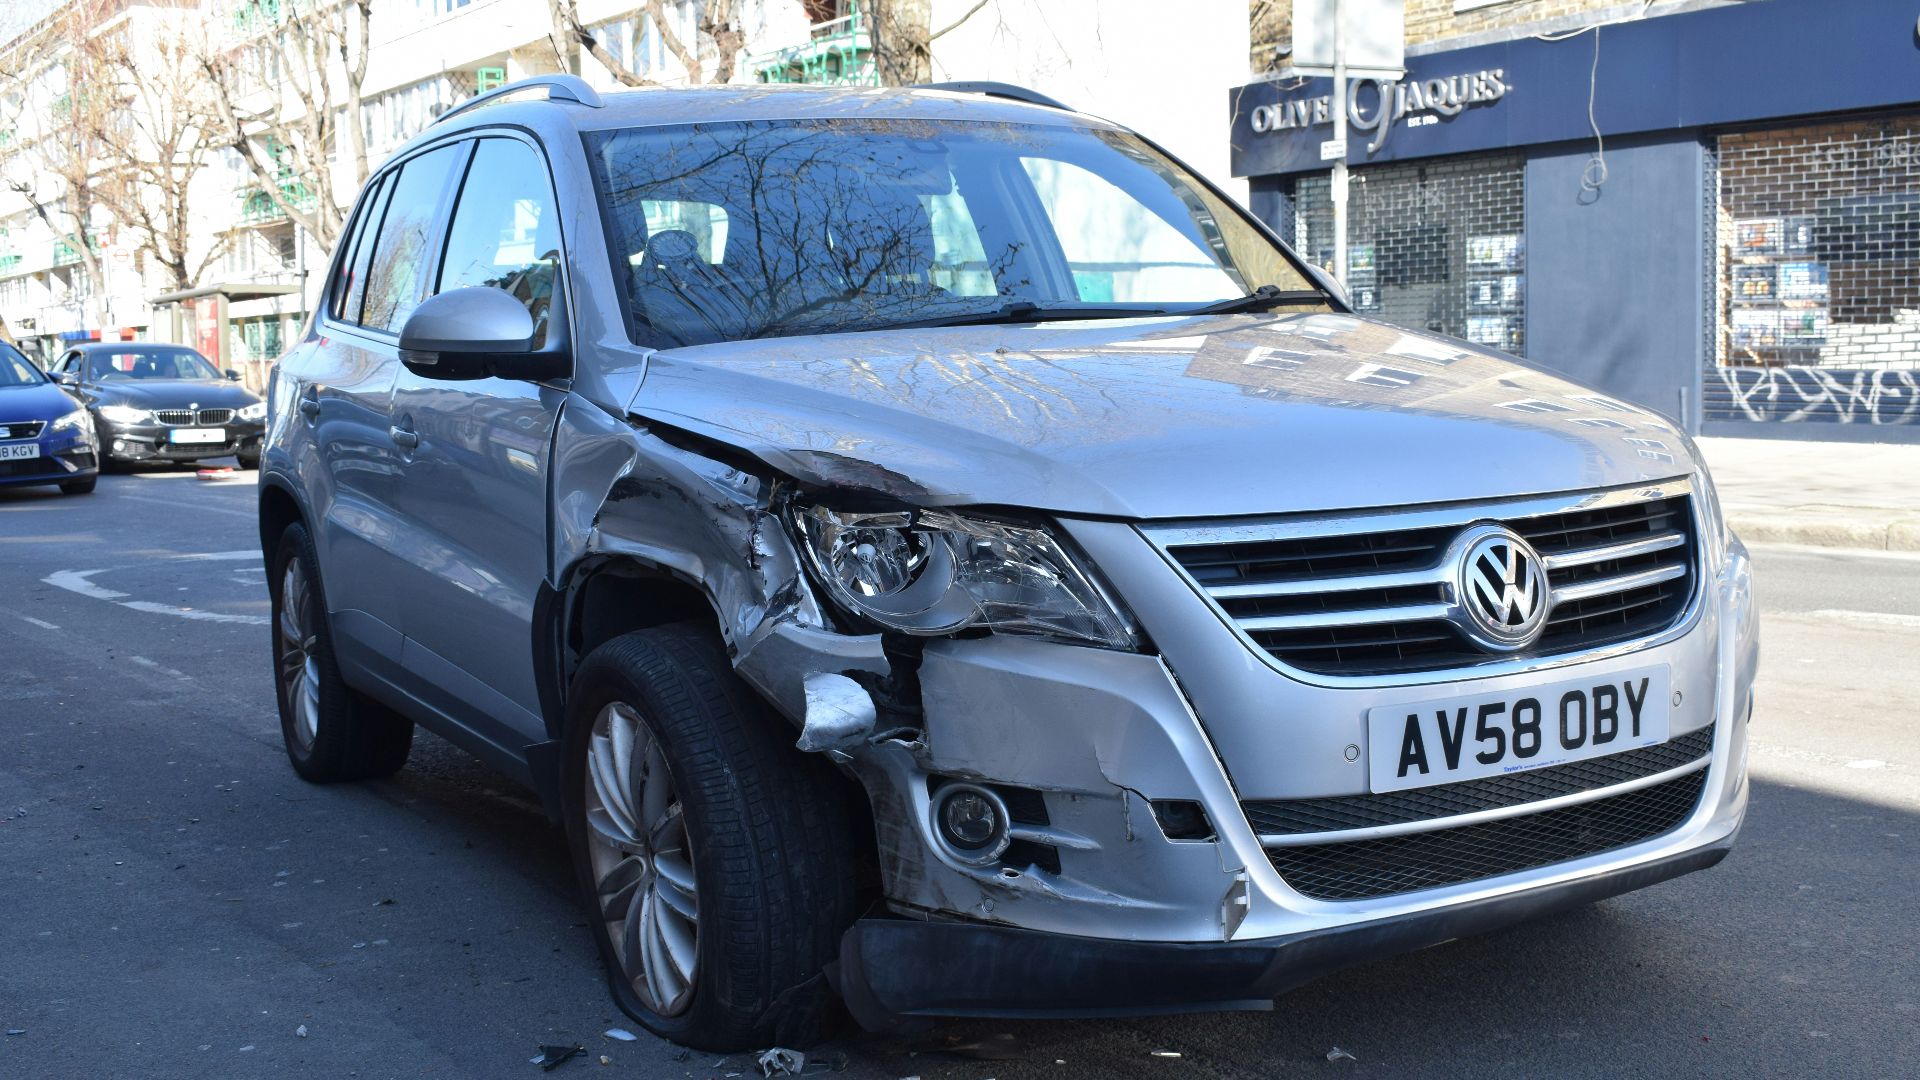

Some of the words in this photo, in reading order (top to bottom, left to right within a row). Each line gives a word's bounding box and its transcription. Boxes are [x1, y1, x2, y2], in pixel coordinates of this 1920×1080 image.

[1393, 69, 1505, 119] JAQUES
[0, 447, 9, 458] 8
[12, 446, 34, 458] KGV
[1396, 697, 1542, 778] AV58
[1559, 677, 1650, 751] OBY
